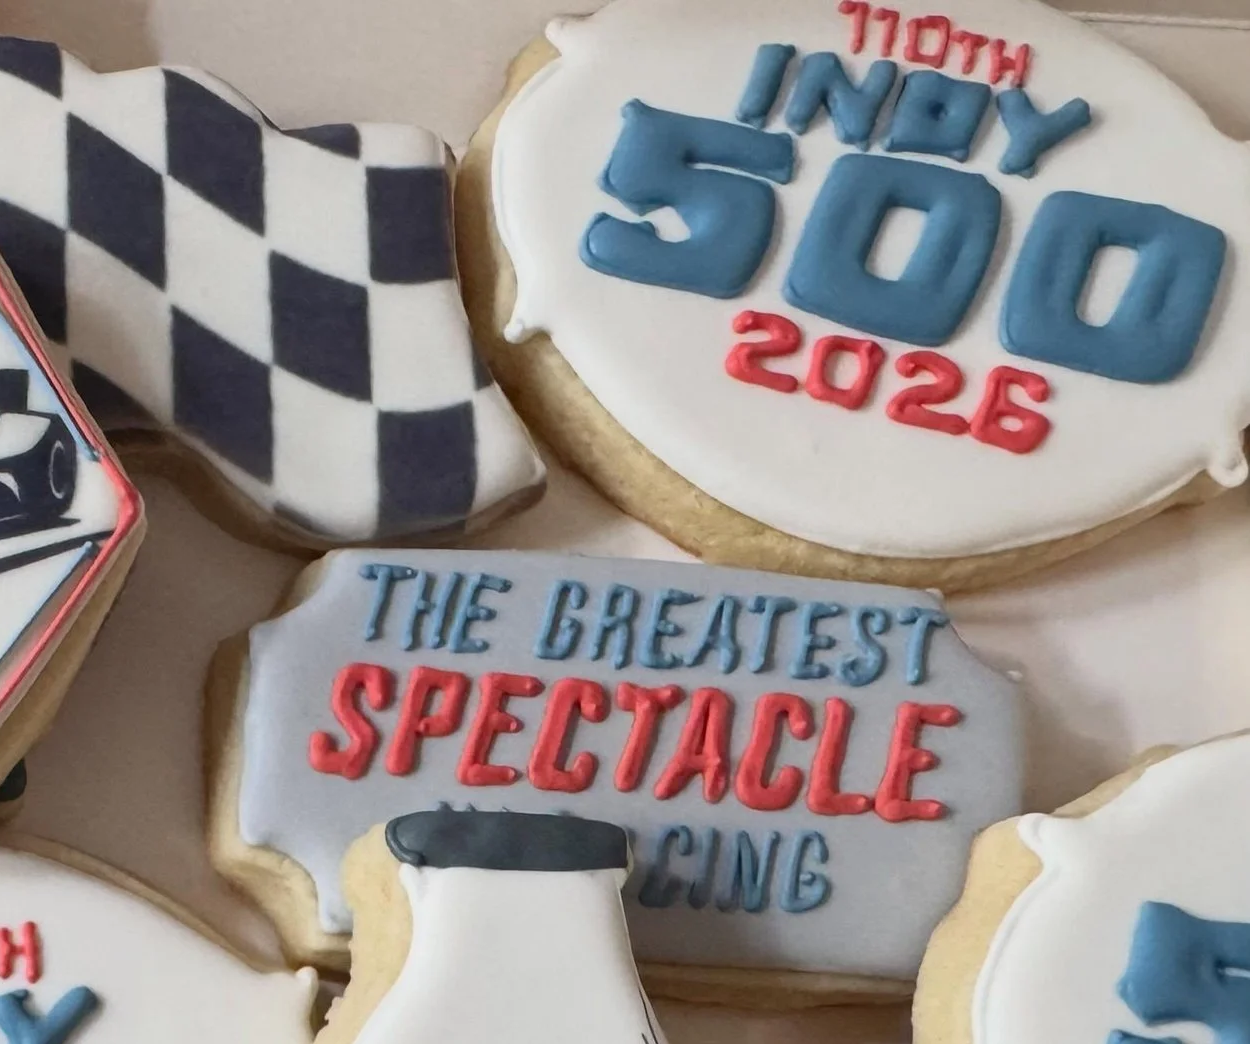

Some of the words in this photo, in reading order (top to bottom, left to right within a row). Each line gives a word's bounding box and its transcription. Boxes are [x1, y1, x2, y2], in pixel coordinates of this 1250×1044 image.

[736, 43, 1092, 178] INDY
[838, 0, 1031, 88] 110TH
[579, 98, 1228, 385] 500
[725, 310, 1051, 454] 2026
[358, 563, 512, 655] THE
[533, 578, 950, 687] GREATEST
[307, 662, 963, 822] SPECTACLE
[628, 824, 834, 914] CING
